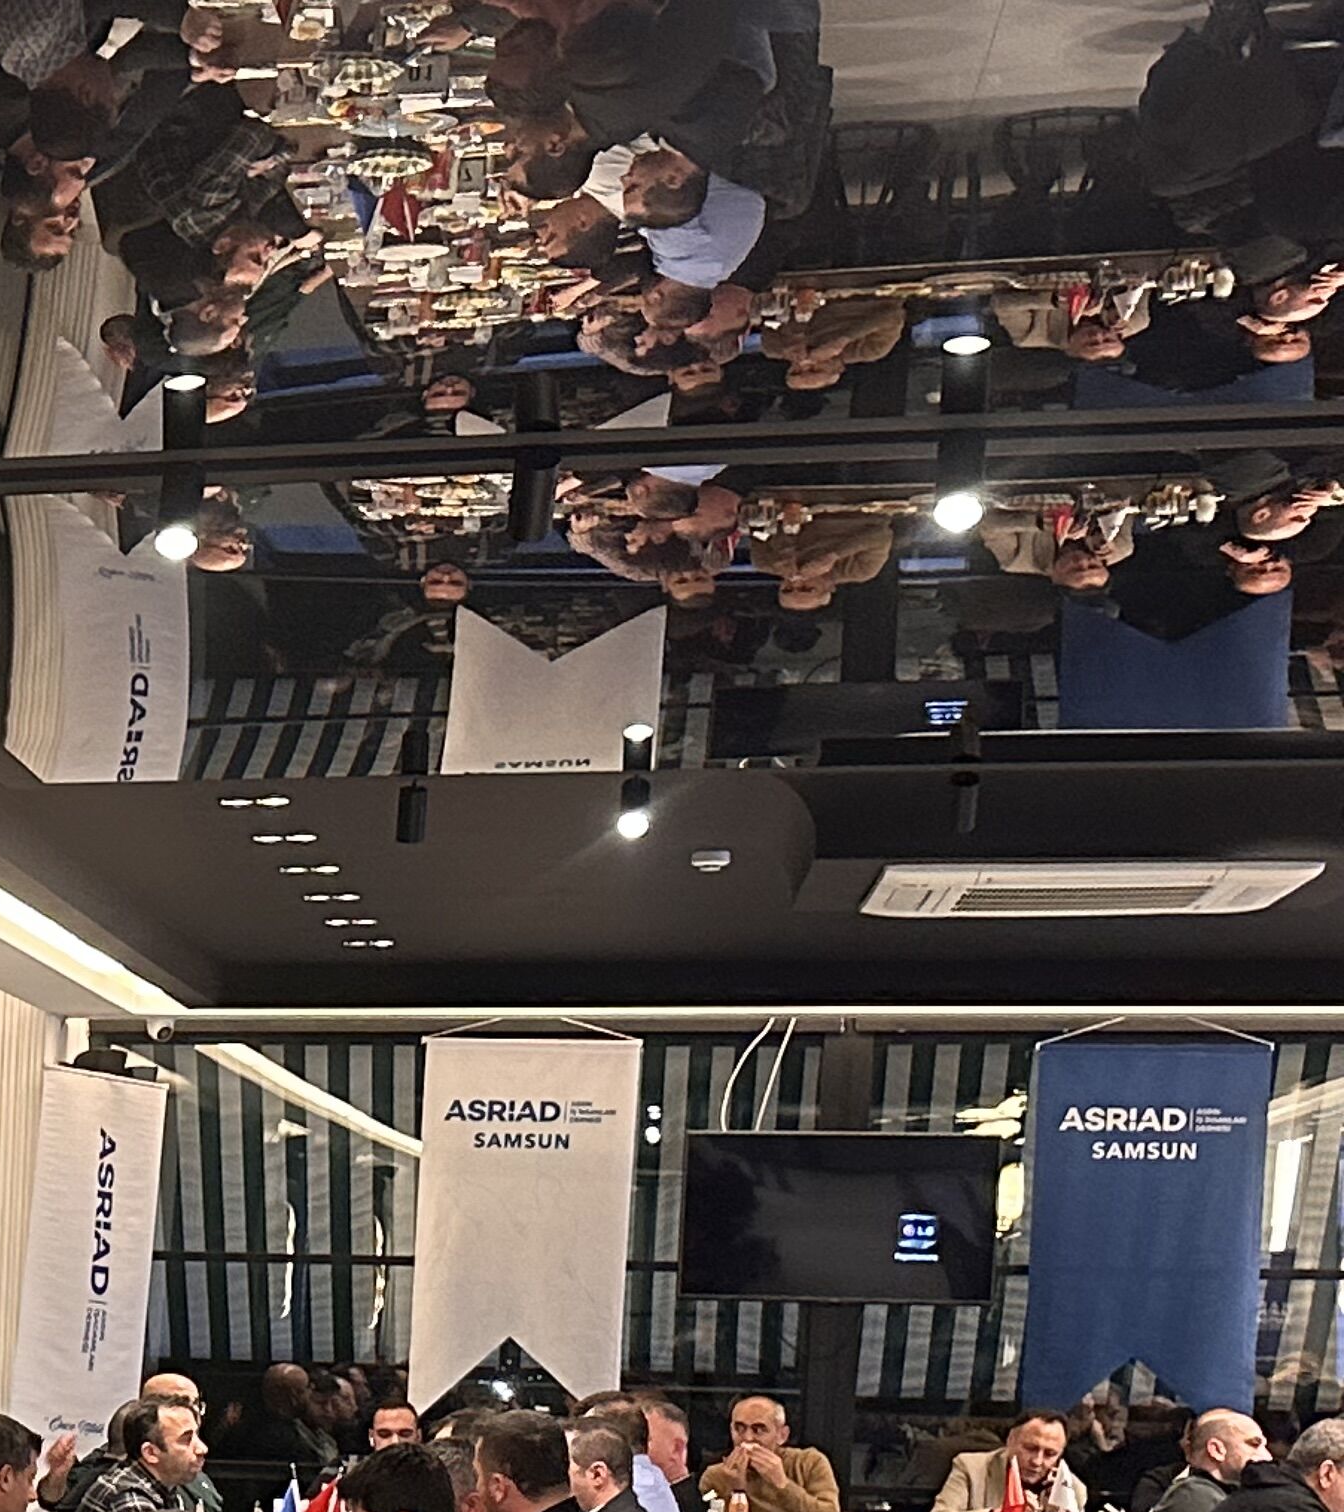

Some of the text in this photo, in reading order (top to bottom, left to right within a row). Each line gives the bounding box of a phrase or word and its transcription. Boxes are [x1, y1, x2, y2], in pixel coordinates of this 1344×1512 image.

[444, 1100, 561, 1122] ASRIAD
[1059, 1107, 1187, 1132] ASRIAD
[473, 1132, 570, 1149] SAMSUN
[1091, 1141, 1198, 1160] SAMSUN
[89, 1127, 117, 1297] ASRIAD
